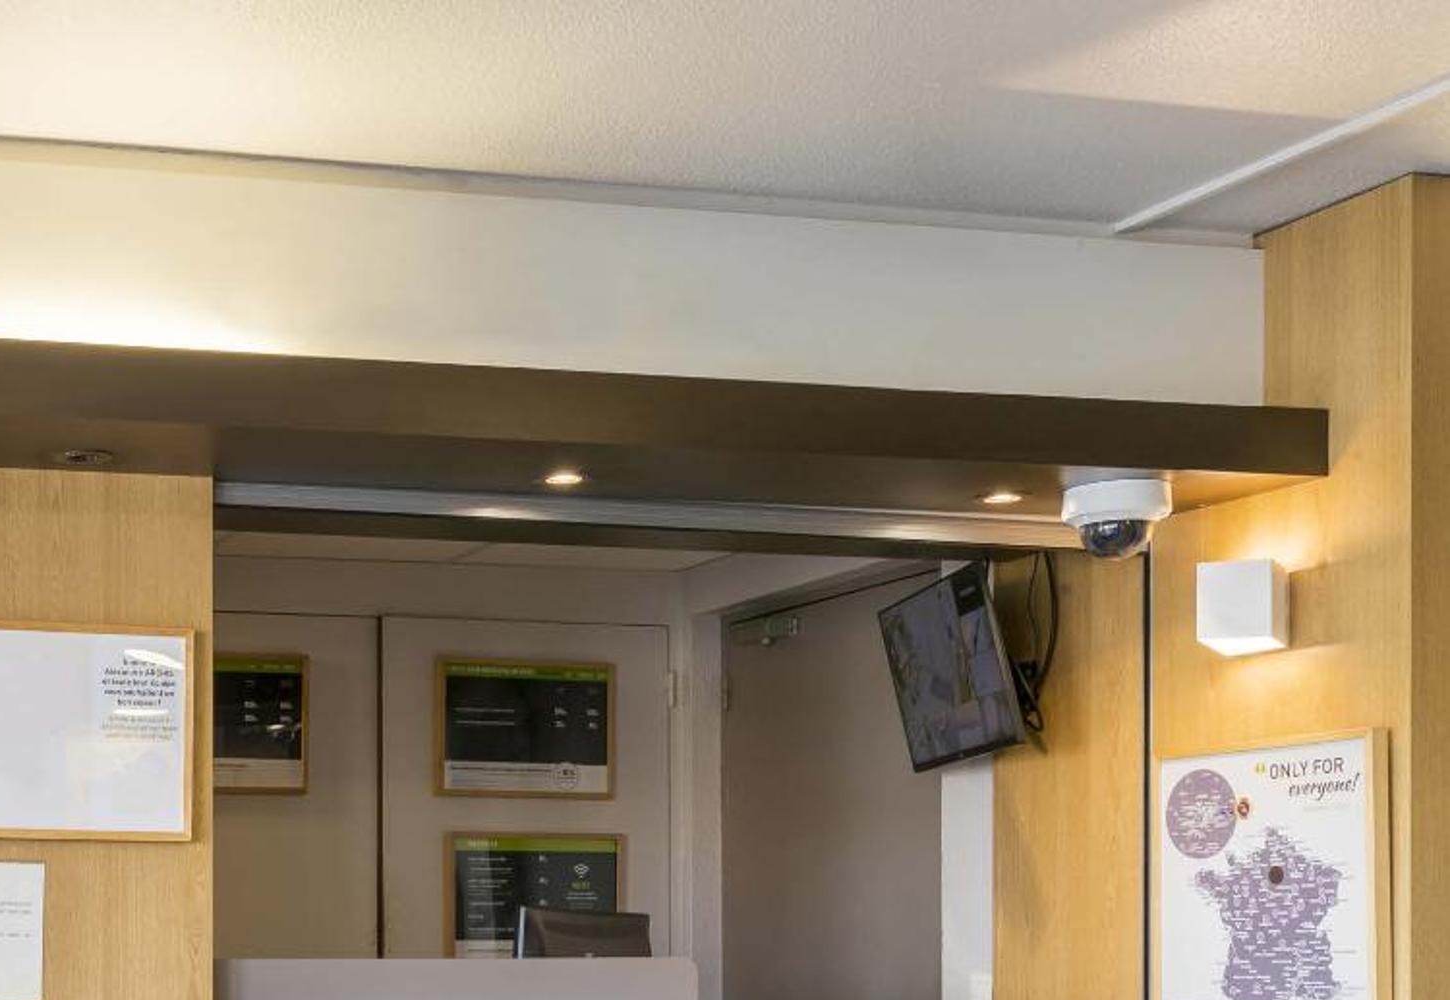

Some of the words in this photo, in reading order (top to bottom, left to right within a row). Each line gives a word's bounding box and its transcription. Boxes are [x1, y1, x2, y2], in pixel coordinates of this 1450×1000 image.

[1269, 761, 1308, 780] ONLY
[1313, 757, 1345, 775] FOR
[1289, 772, 1361, 801] everyone!
